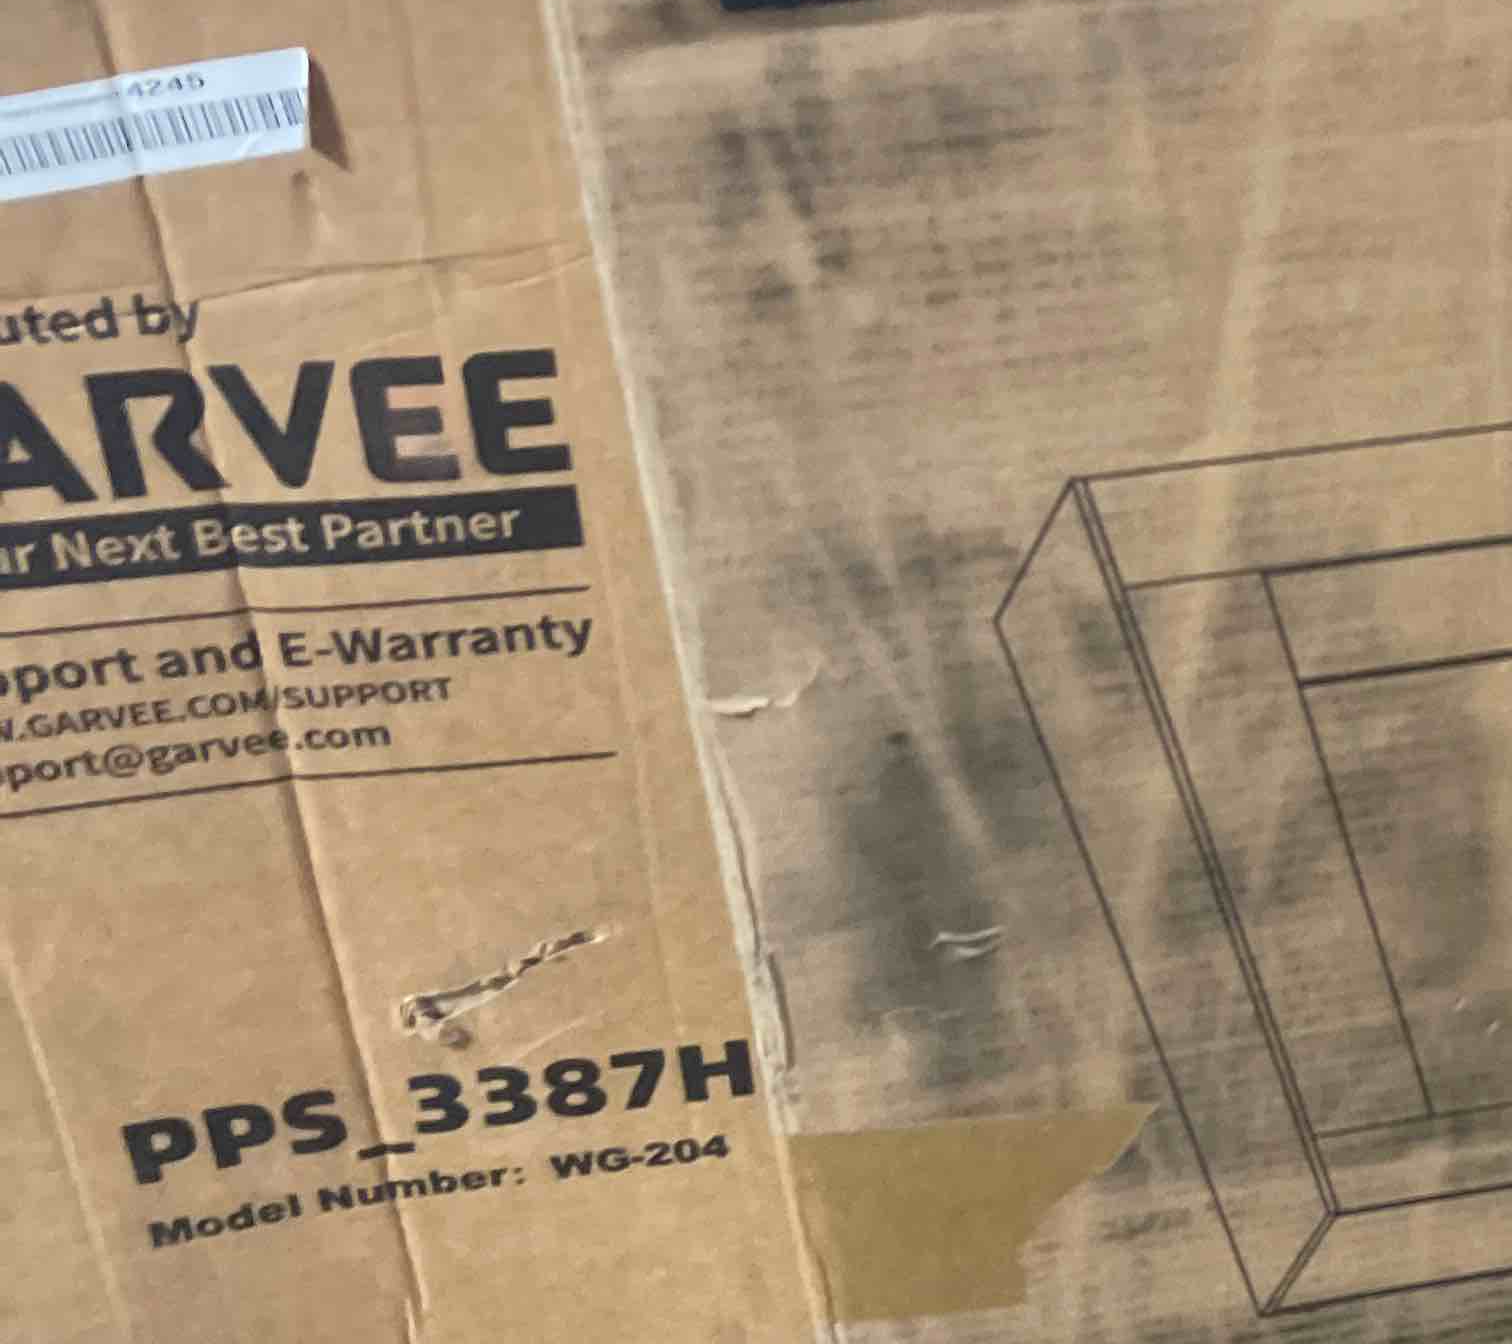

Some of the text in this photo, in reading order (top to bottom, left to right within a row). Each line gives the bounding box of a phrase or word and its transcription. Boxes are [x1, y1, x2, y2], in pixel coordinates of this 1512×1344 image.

[0, 294, 198, 347] uted by
[0, 348, 572, 502] ARVEE
[51, 523, 180, 573] Next
[192, 513, 307, 557] Best
[322, 506, 520, 551] Partner
[0, 614, 592, 704] port and E-Warranty
[0, 676, 452, 746] .GARVEE.COM/SUPPORT
[0, 722, 391, 792] port@garvee.com
[122, 1038, 755, 1185] PPS_3387H
[147, 1136, 731, 1249] Model Number: WG-204
